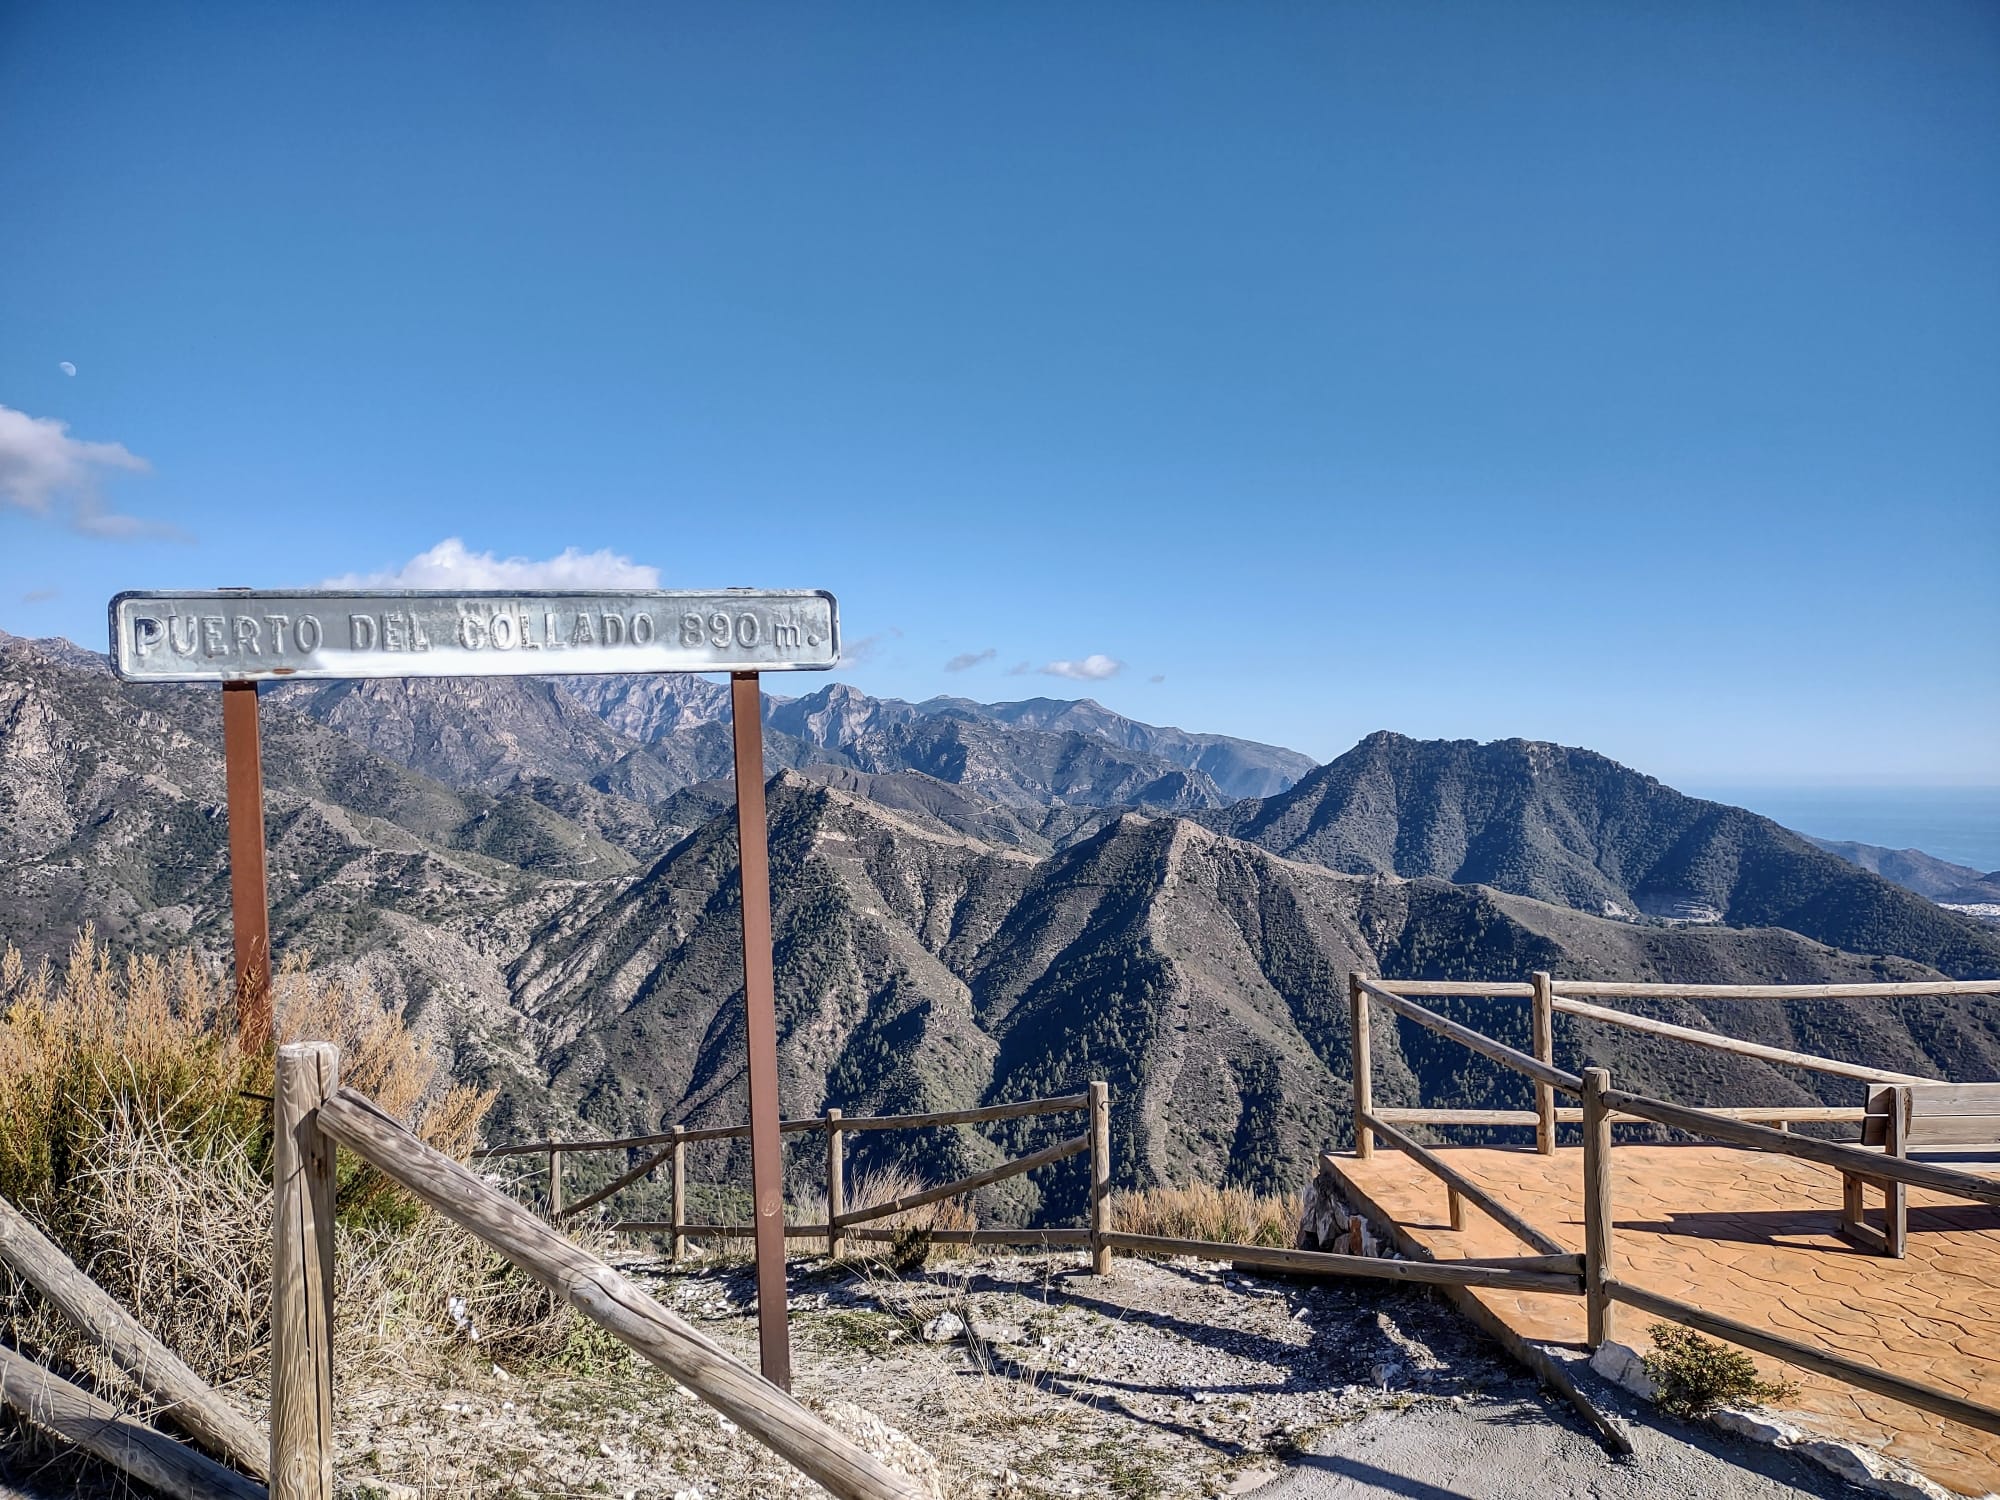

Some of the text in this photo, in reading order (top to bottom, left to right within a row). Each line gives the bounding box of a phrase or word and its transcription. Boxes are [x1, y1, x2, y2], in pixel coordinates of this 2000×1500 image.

[135, 614, 323, 657] PUERTO
[349, 613, 431, 651] DEL
[458, 612, 656, 651] COLLADO
[679, 611, 760, 649] 890
